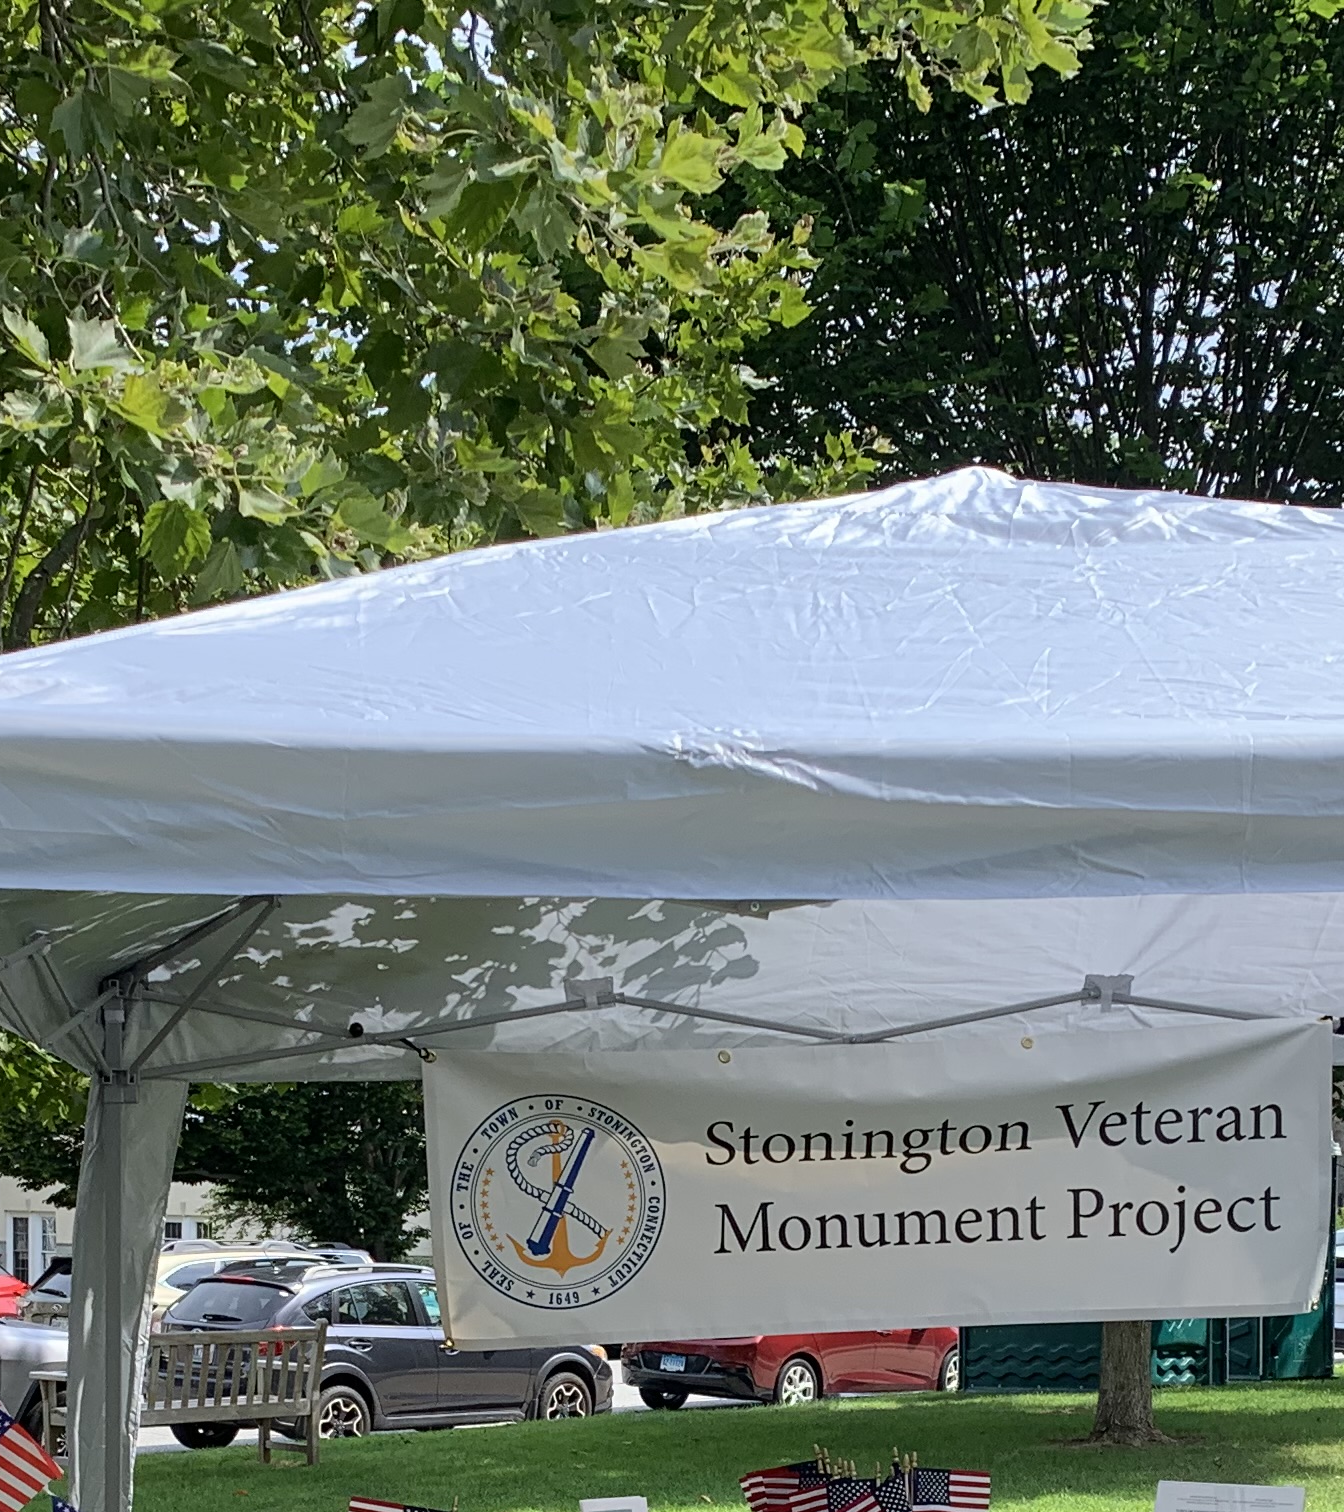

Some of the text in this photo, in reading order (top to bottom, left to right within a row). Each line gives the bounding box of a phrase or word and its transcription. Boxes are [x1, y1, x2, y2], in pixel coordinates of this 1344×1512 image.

[705, 1100, 1287, 1175] Stonington Veteran
[456, 1099, 660, 1291] SEAL OF THE TOWN OF STONINGTON CONNECTICUT
[713, 1185, 1281, 1254] Monument Project
[548, 1292, 580, 1305] 1649
